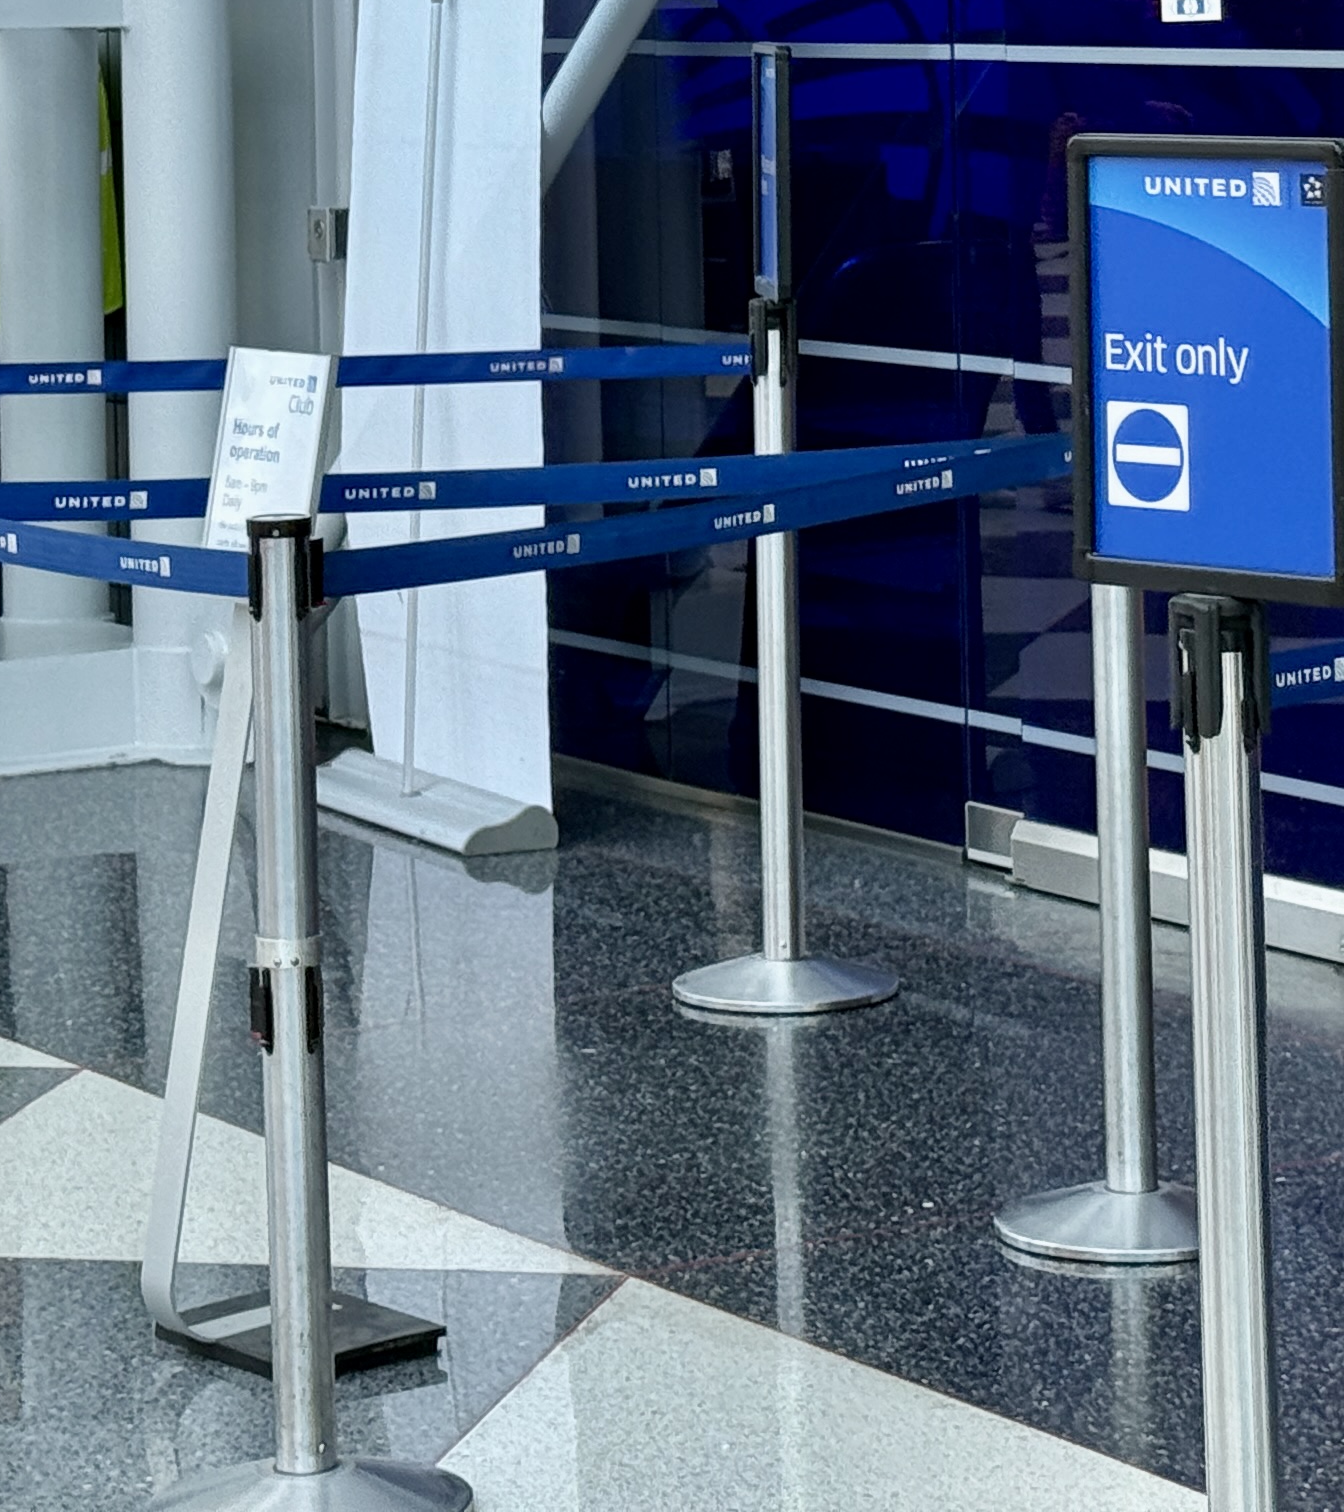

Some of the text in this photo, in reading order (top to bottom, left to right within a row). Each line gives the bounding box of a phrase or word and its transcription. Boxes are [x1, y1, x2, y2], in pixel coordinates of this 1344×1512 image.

[1145, 176, 1246, 198] UNITED
[490, 360, 546, 373] UNITED
[1105, 333, 1248, 384] Exit only
[28, 373, 84, 384] UNITED
[233, 418, 280, 438] Hours of
[229, 446, 280, 463] operation
[628, 473, 696, 489] UNITED
[896, 477, 940, 495] UNITED
[345, 486, 415, 499] UNITED
[55, 495, 126, 508] UNITED
[714, 511, 761, 529] UNITED
[513, 539, 564, 559] UNITED
[120, 556, 158, 573] UNITED
[1275, 664, 1333, 687] UNITED
